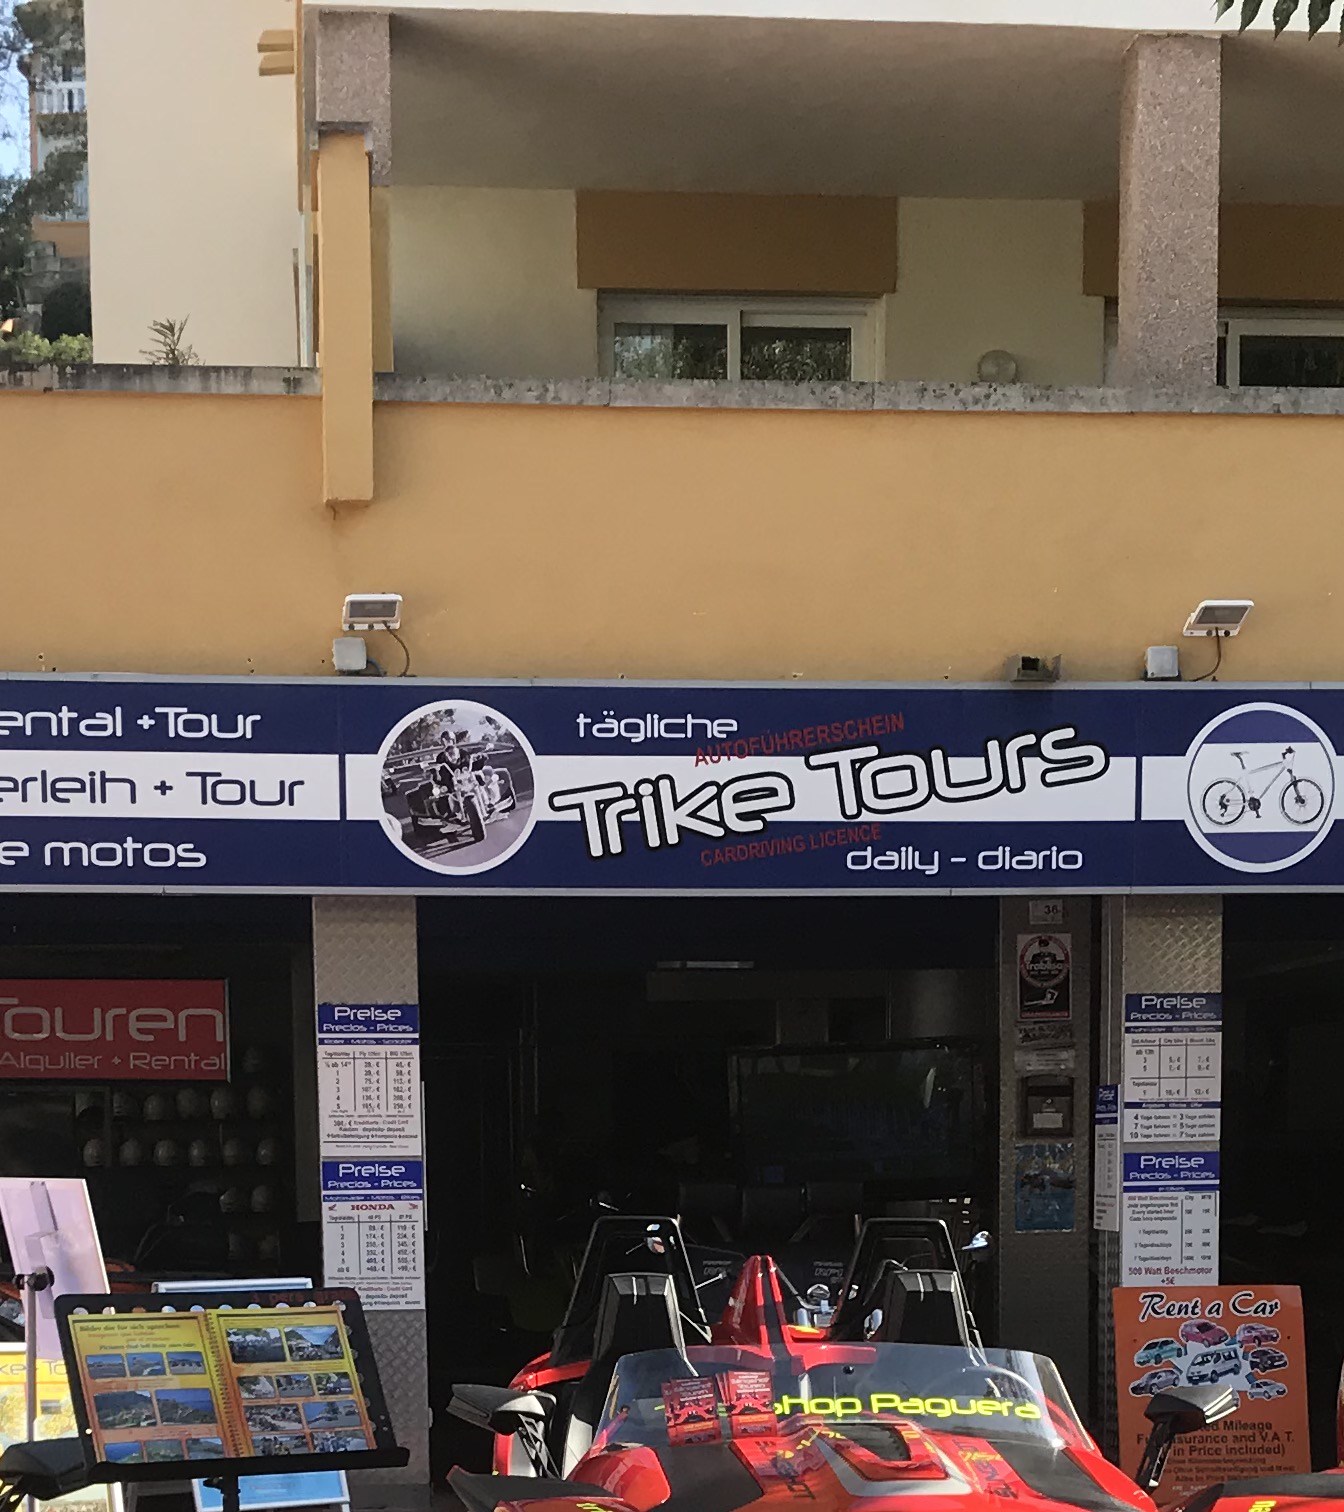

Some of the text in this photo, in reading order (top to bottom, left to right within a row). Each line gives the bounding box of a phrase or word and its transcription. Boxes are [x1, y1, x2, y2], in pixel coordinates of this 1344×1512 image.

[575, 710, 739, 743] tägliche
[693, 712, 906, 768] AUTOFÜHRERSCHEIN
[153, 779, 175, 797] +
[185, 770, 306, 807] Tour
[550, 725, 1110, 860] Trike Tours
[43, 836, 208, 869] motos
[700, 823, 883, 867] CARDRIVING LICENCE
[845, 846, 940, 875] daily
[976, 846, 1084, 872] diario
[1141, 995, 1207, 1009] Preise
[334, 1006, 402, 1021] Preise
[128, 1051, 227, 1072] Rental
[338, 1163, 406, 1177] Preise
[1139, 1155, 1205, 1169] Preise
[350, 1203, 396, 1212] HONDA
[1144, 1267, 1163, 1275] Watt
[1140, 1291, 1281, 1321] Rent a Car
[870, 1393, 1042, 1420] Paguera
[1223, 1420, 1273, 1432] Mileage
[1172, 1434, 1228, 1445] surance
[1232, 1433, 1257, 1444] and
[1172, 1444, 1287, 1457] in Price included)
